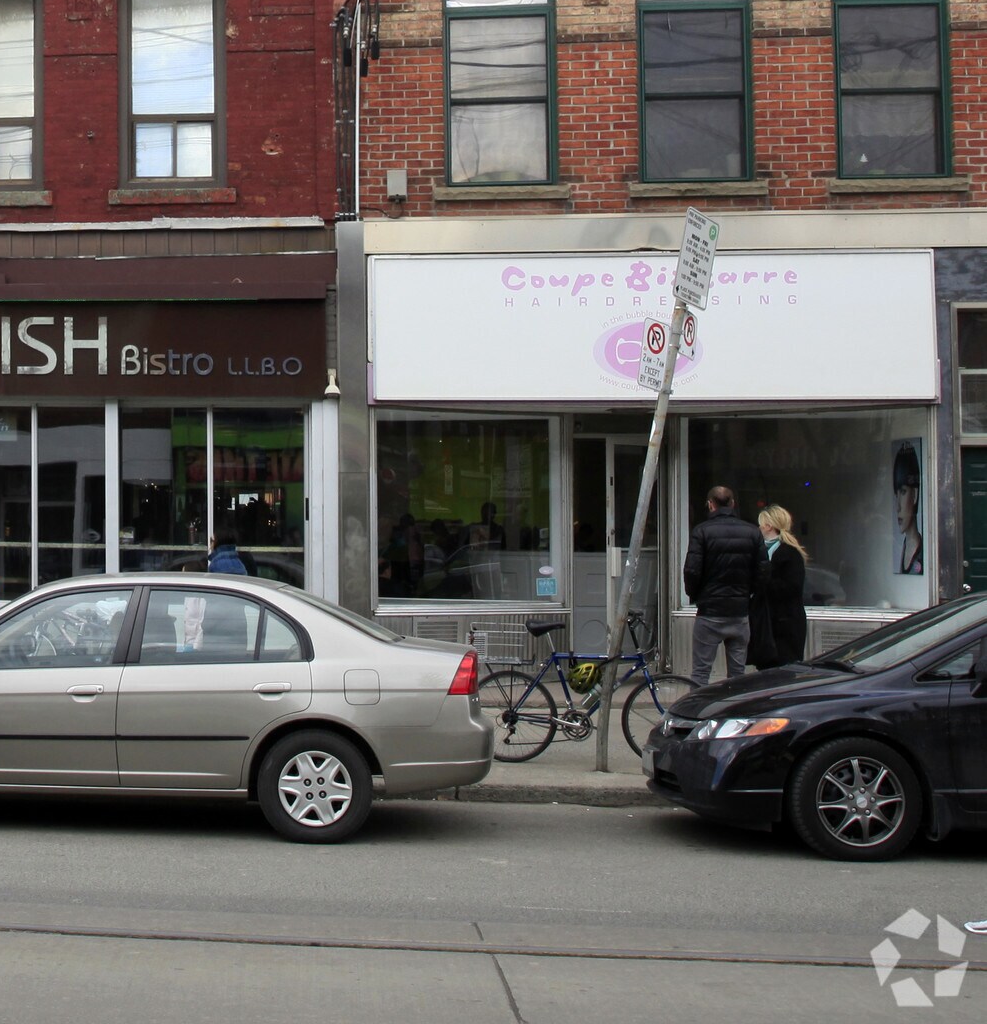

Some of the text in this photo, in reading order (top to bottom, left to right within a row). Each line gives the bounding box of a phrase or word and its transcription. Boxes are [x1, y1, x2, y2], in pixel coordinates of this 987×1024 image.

[500, 261, 798, 296] Coupe Biarre
[504, 295, 798, 307] HAIRDRESING
[610, 315, 624, 324] the
[626, 310, 653, 320] bubble
[121, 344, 214, 376] Bistro
[644, 365, 661, 378] EXCEPT
[639, 374, 662, 389] BY PERMIT
